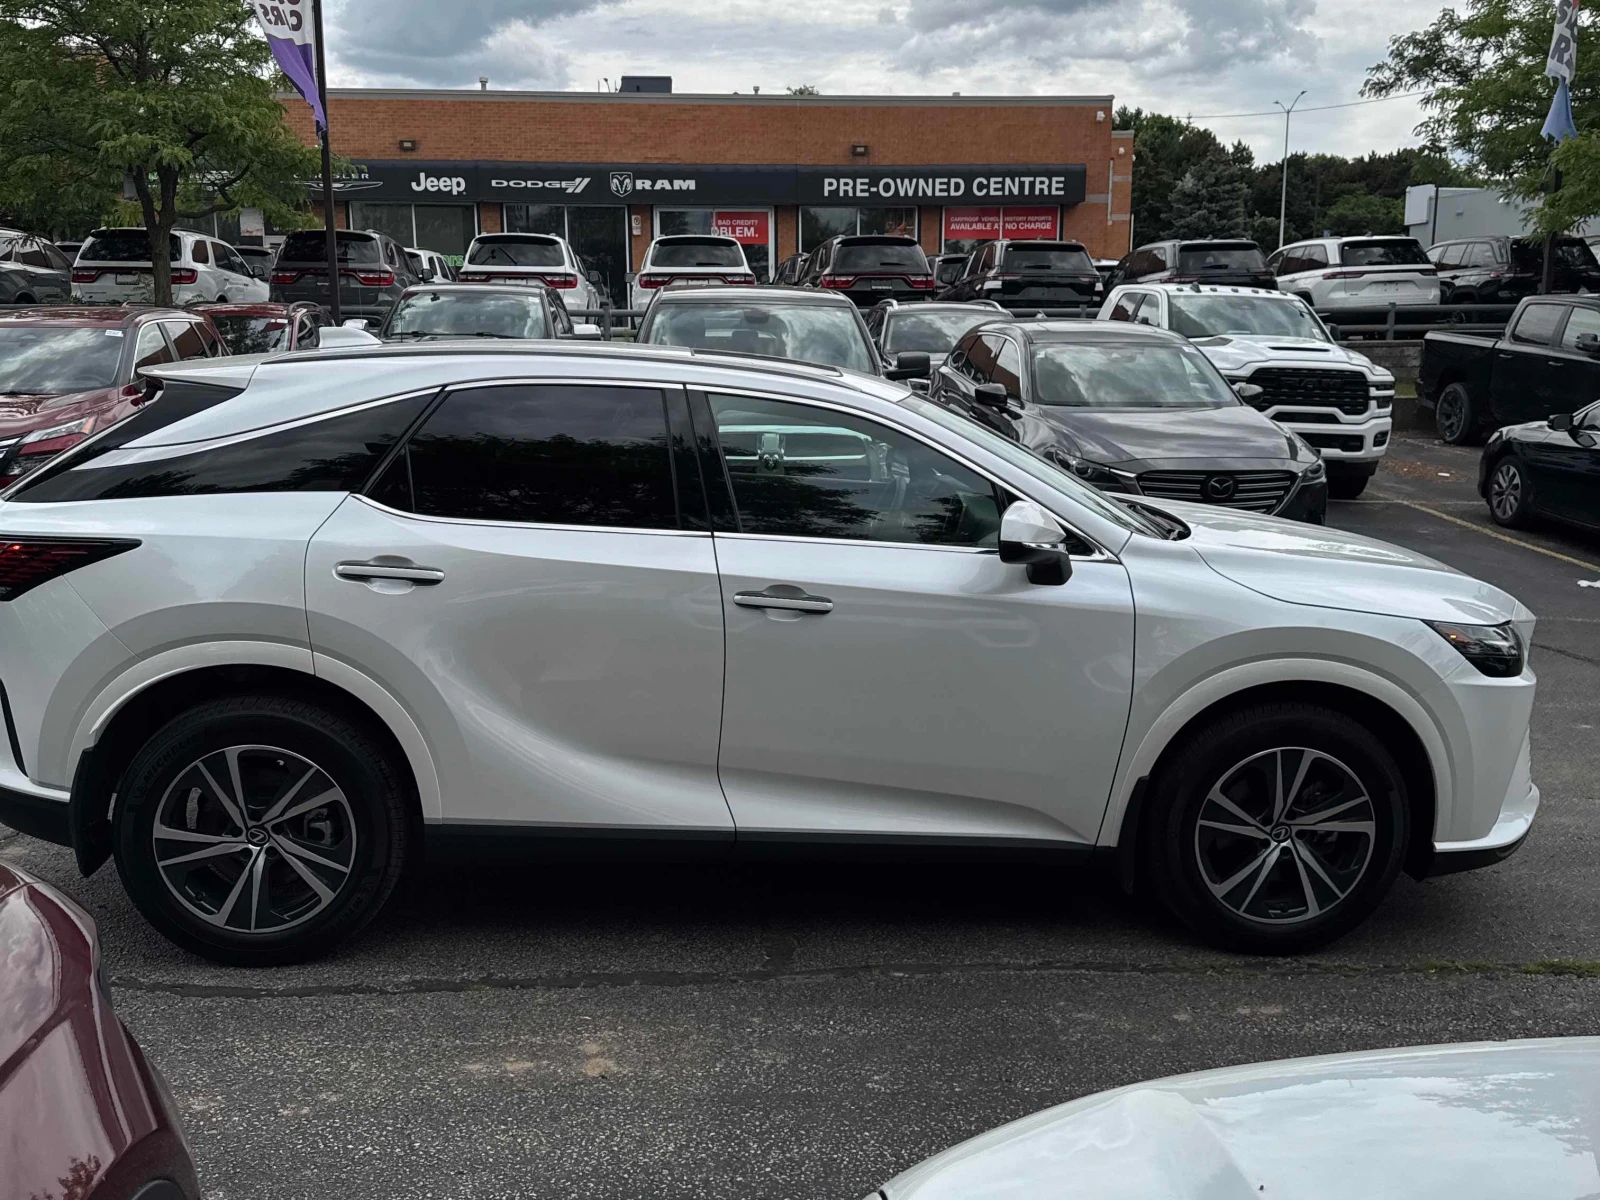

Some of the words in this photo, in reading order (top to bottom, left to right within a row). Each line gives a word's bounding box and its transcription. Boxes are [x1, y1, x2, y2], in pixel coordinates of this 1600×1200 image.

[411, 172, 466, 195] Jeep
[491, 179, 577, 189] DODGE
[635, 179, 696, 190] RAM
[823, 178, 965, 197] PRE-OWNED
[972, 176, 1065, 196] CENTRE
[950, 222, 992, 230] AVAILABLE
[1005, 222, 1018, 230] NO
[1018, 222, 1052, 230] CHARGE
[442, 254, 465, 267] ars
